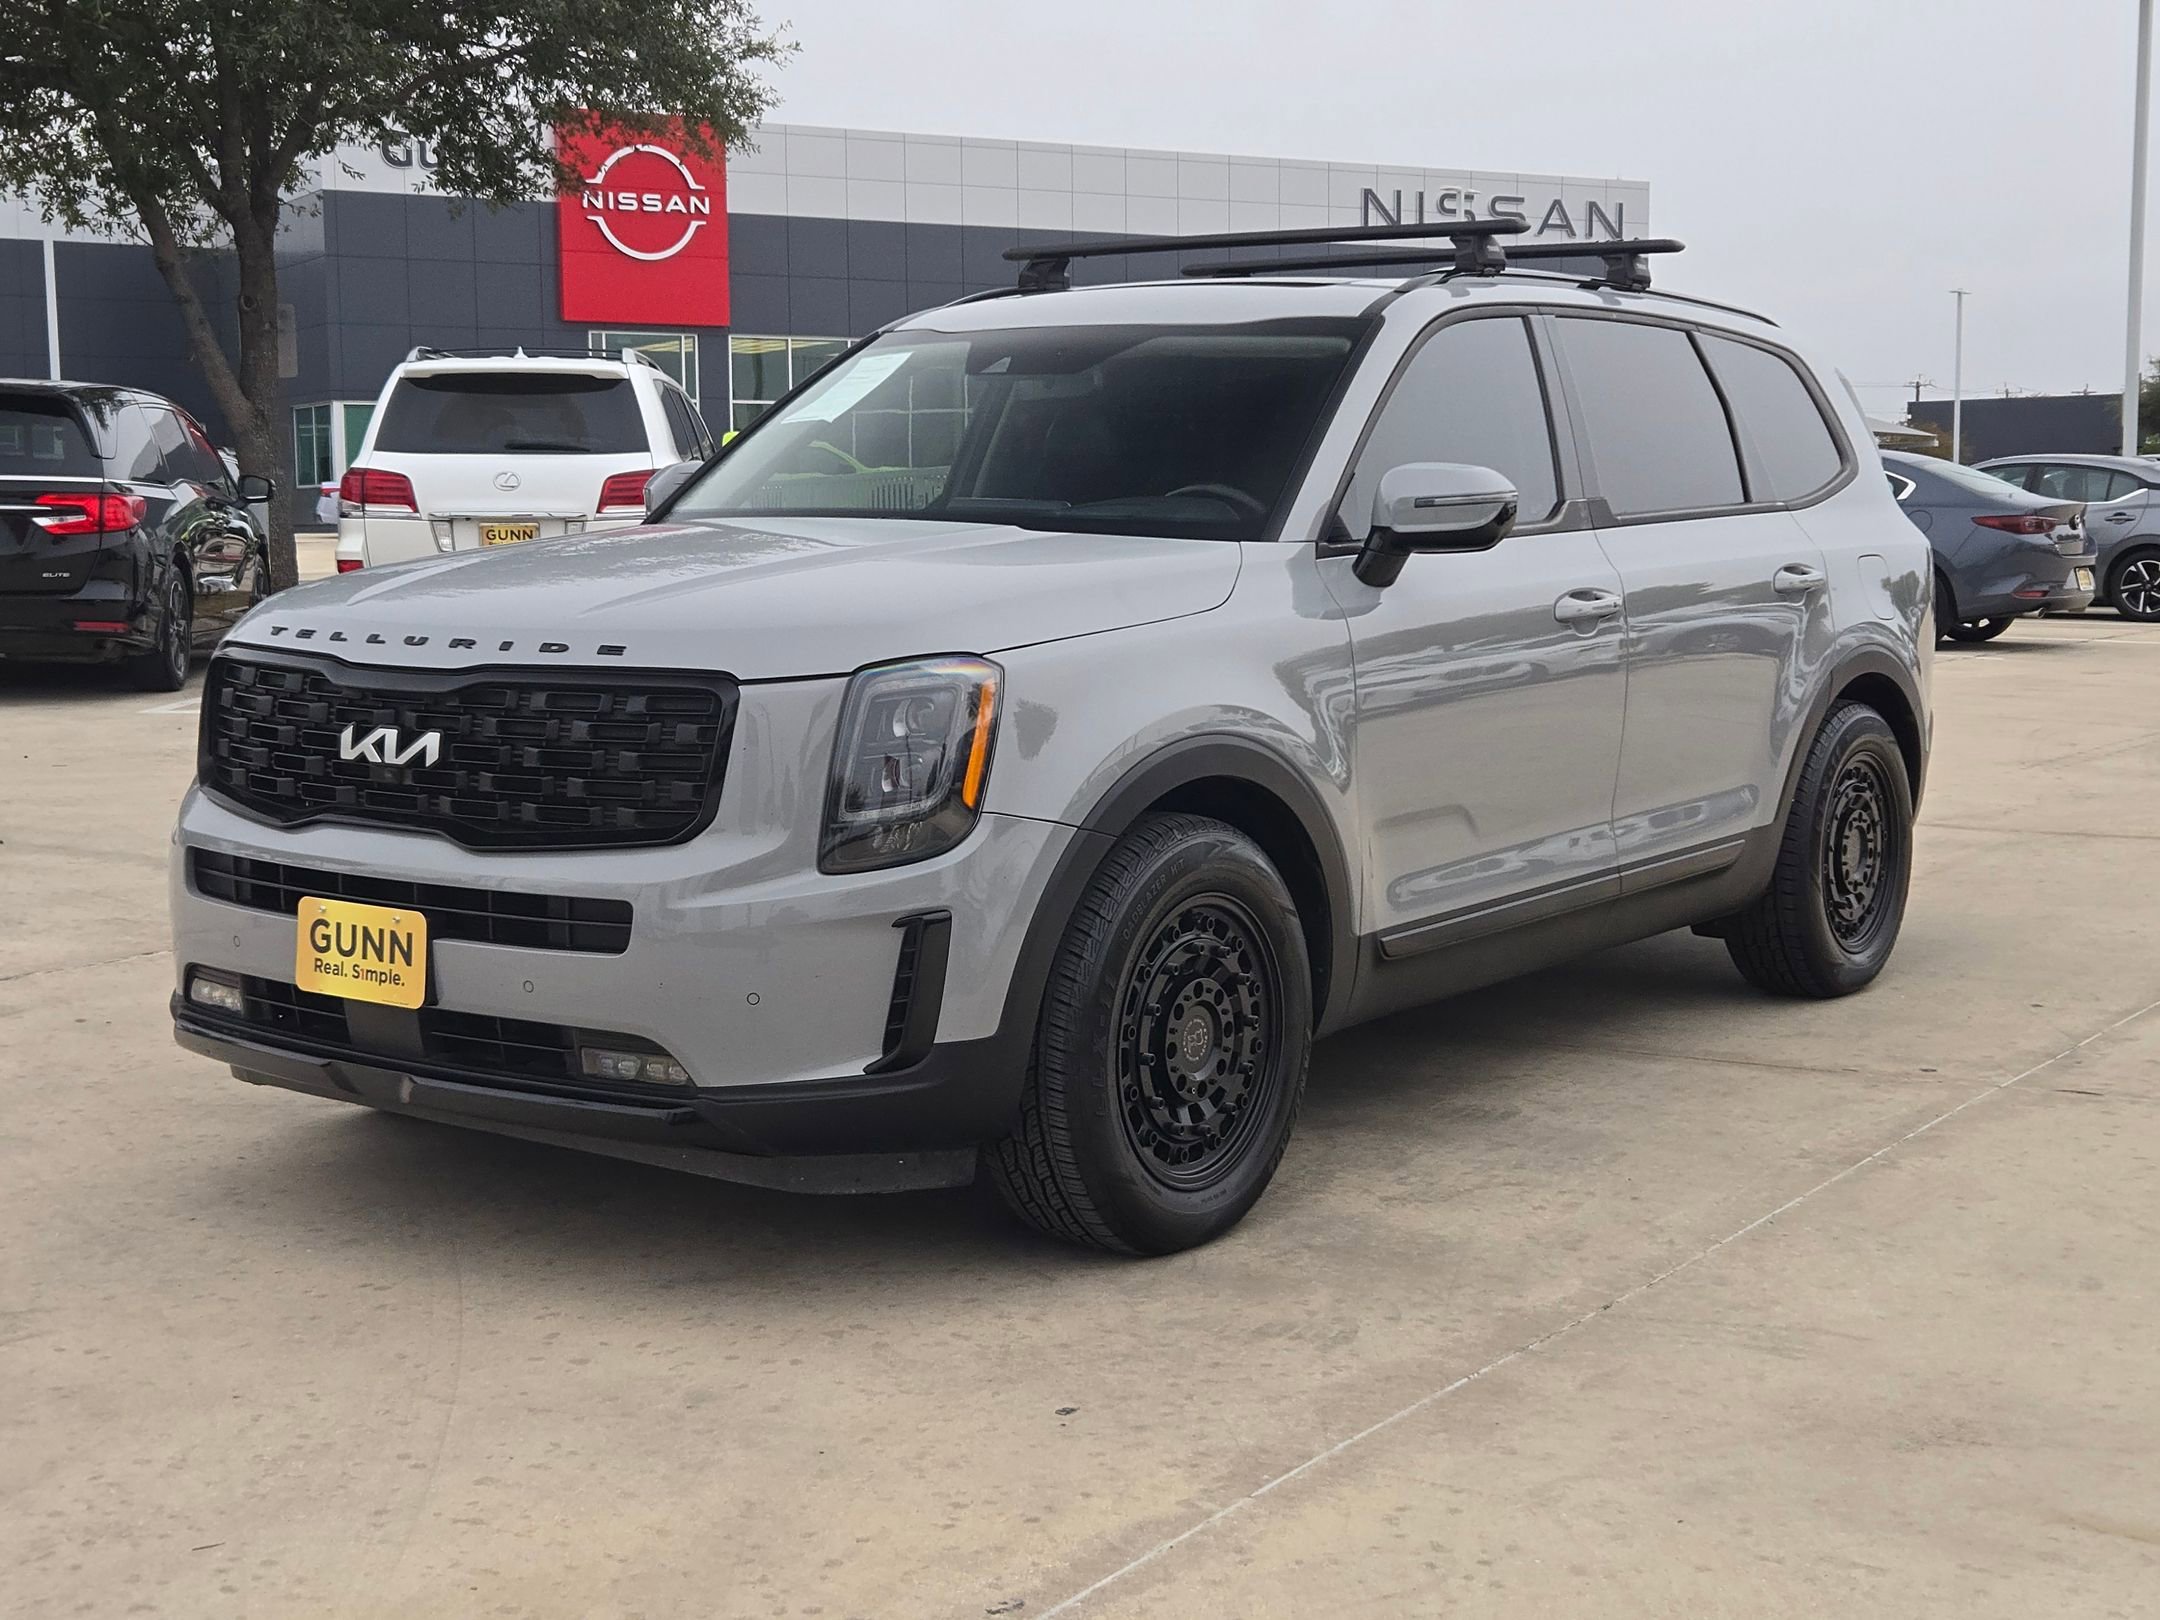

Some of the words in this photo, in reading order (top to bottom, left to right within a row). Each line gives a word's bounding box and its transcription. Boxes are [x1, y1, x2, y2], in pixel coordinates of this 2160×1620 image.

[583, 190, 710, 214] NISSAN
[1361, 187, 1624, 240] NISSAN
[486, 529, 534, 541] GUNN
[270, 625, 627, 656] TELLURIDE
[309, 918, 413, 967] GUNN
[314, 957, 348, 978] Real.
